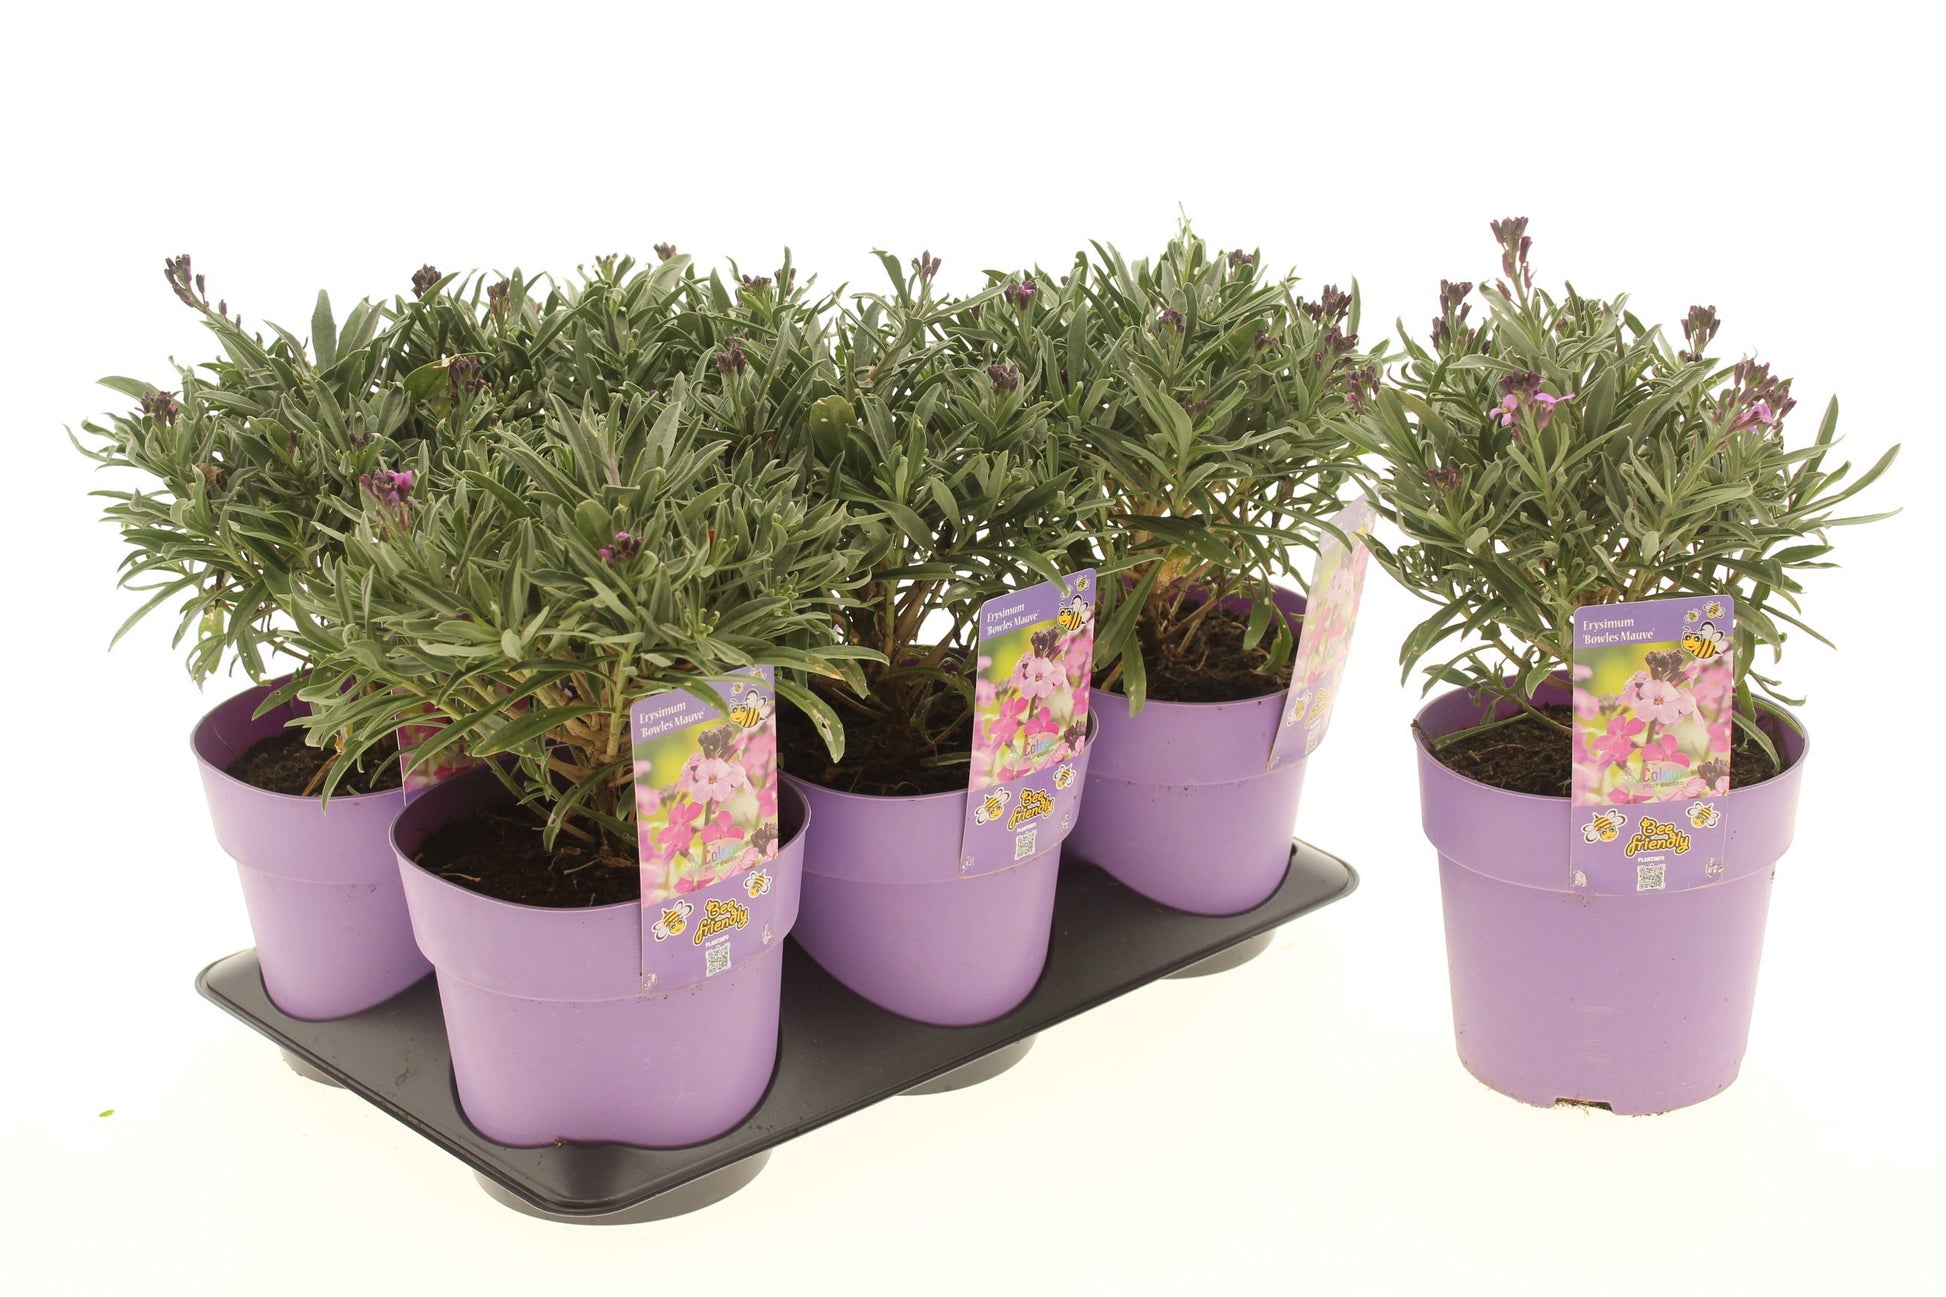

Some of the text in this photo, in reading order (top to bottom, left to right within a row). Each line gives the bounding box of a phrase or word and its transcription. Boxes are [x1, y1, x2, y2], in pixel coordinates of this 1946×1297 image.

[987, 604, 1025, 622] Erysimum
[1583, 617, 1634, 632] Erysimum
[639, 702, 687, 724] Erysimum
[1020, 788, 1046, 807] Bee
[1007, 795, 1055, 831] friendly
[1640, 817, 1675, 836] Bee
[1625, 829, 1691, 857] friendly
[704, 898, 736, 919] Bee
[693, 903, 750, 946] friendly
